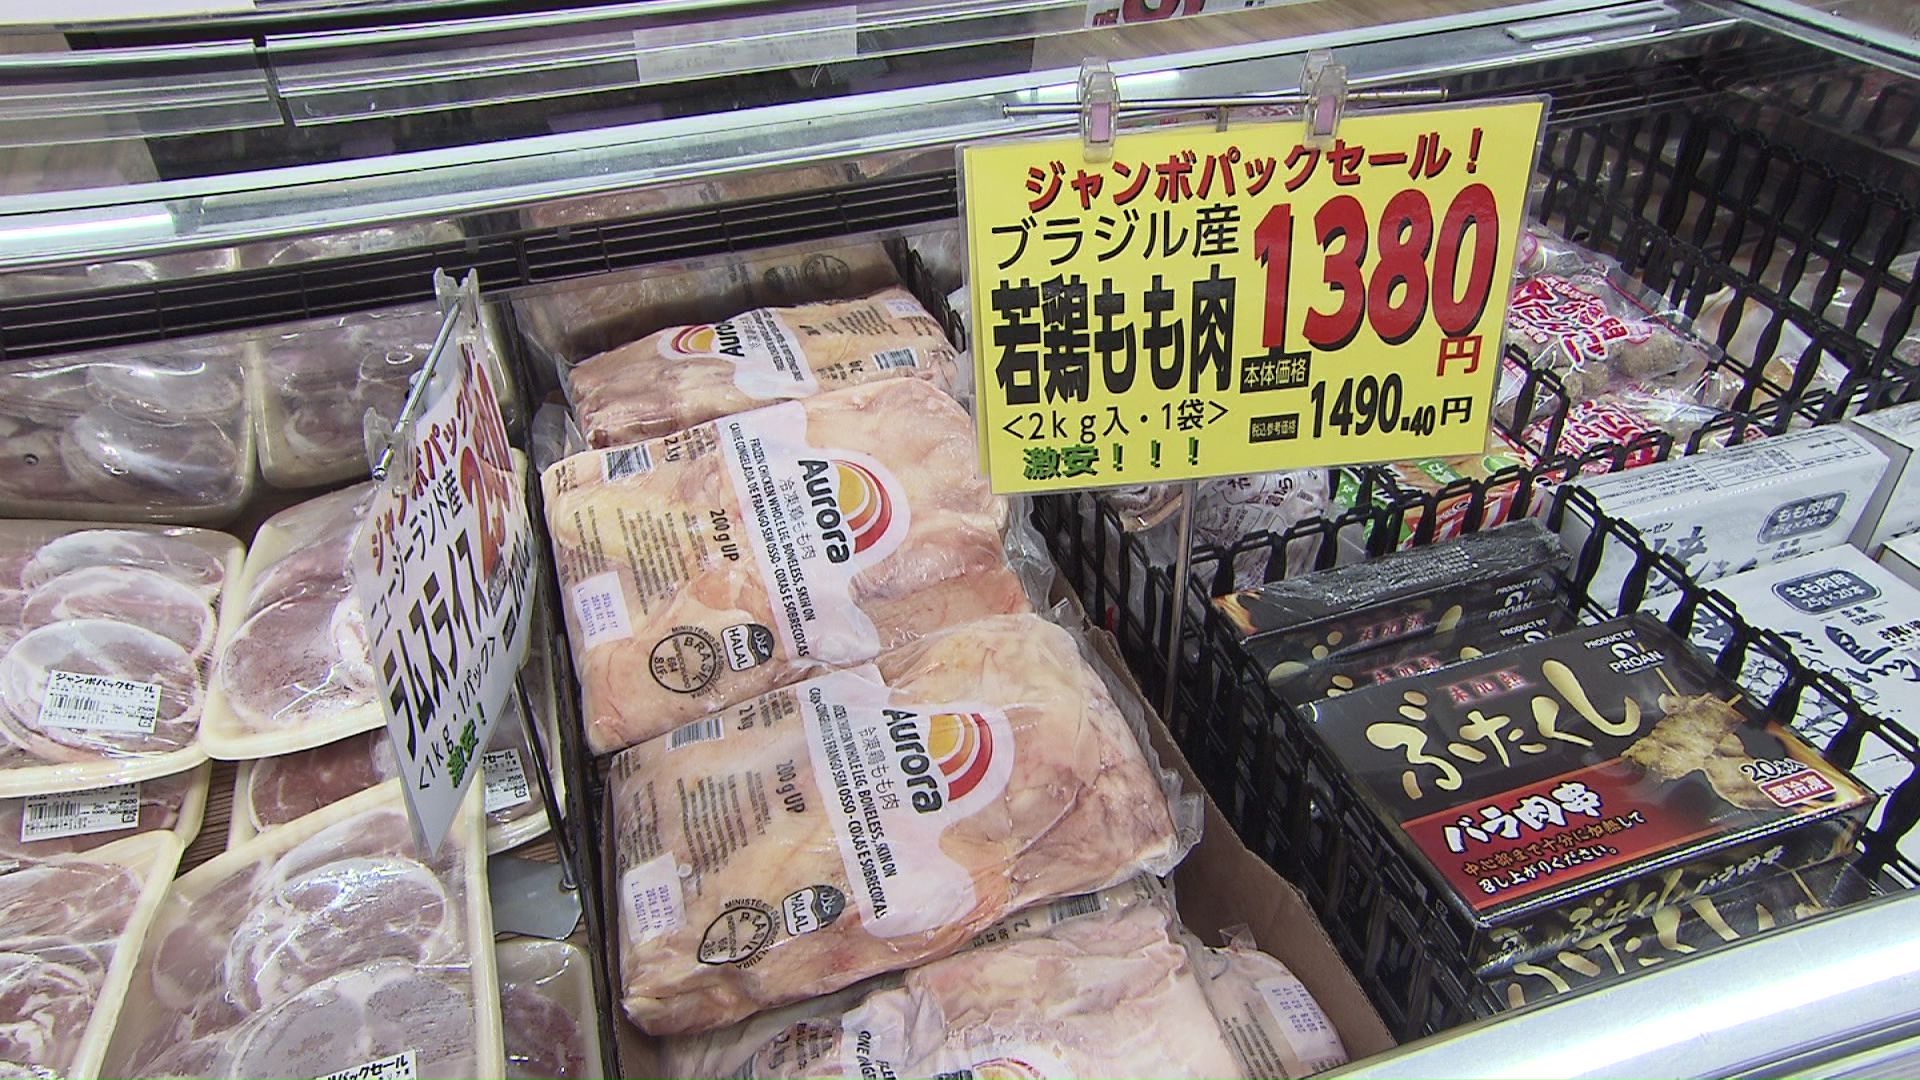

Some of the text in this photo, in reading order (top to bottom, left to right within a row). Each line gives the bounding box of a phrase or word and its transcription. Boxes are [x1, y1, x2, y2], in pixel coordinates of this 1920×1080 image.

[991, 202, 1241, 270] ブラジル産
[1252, 182, 1499, 358] 1380
[991, 263, 1237, 406] 若鶏もも肉
[1436, 334, 1482, 378] 円
[1243, 357, 1308, 387] 本体価格
[1310, 372, 1473, 440] 1490.40 円
[664, 437, 678, 446] 2
[748, 482, 759, 494] DE
[752, 493, 770, 527] FRANGO
[768, 497, 787, 526] WHOLE
[798, 460, 850, 564] Aurora
[709, 509, 739, 561] 200 g UP
[767, 543, 781, 563] OSSO
[774, 568, 791, 595] COXAS
[796, 586, 811, 608] SKIN
[1785, 573, 1852, 598] もも肉串
[784, 600, 809, 657] SOBRECOXAS
[803, 608, 816, 621] ON
[383, 528, 489, 762] ラムスライス
[684, 637, 711, 683] BRASIL
[728, 628, 748, 668] HALAL
[1584, 629, 1636, 650] PRODUCT BY
[1608, 650, 1665, 674] PROAN
[739, 705, 752, 715] 2
[1365, 659, 1642, 800] ぶたくし
[882, 709, 943, 814] Aurora
[776, 760, 805, 813] 200 g UP
[838, 788, 856, 814] OSSO
[848, 820, 868, 851] COXAS
[858, 789, 884, 844] BONELESS,
[882, 863, 898, 878] ON
[1443, 781, 1603, 853] バラ肉串
[857, 851, 871, 860] E
[1463, 809, 1647, 877] 中心部まで十分に加熱して
[860, 859, 888, 919] SOBRECOXAS
[1478, 844, 1619, 895] 召し上がりください。
